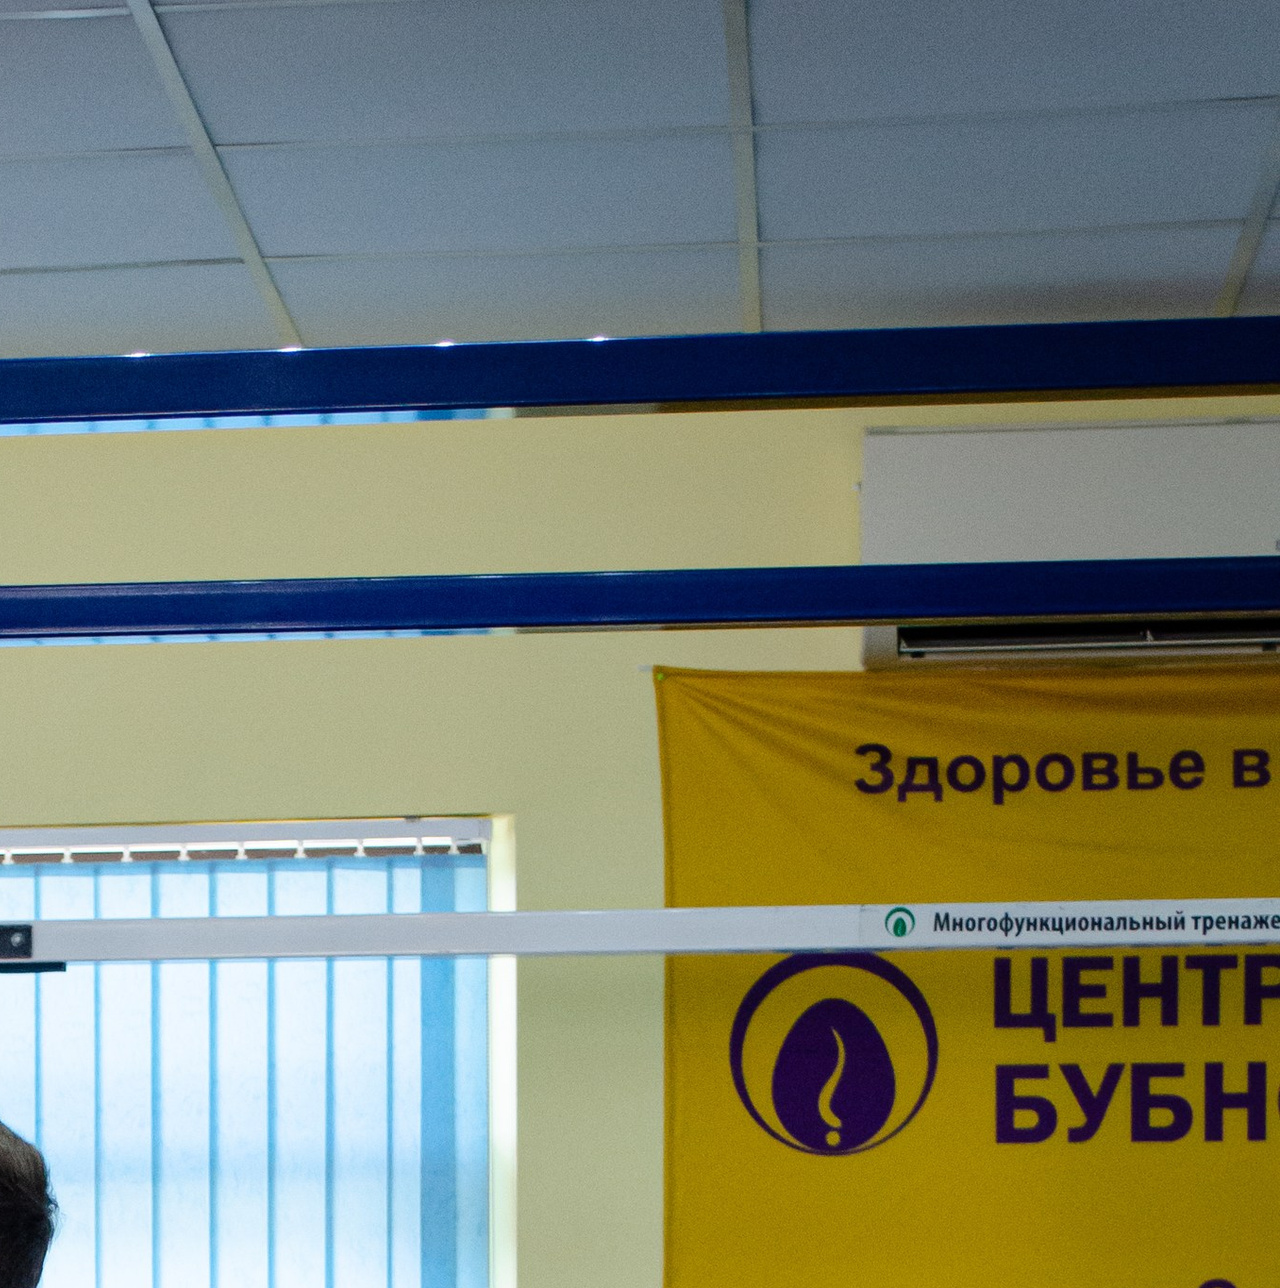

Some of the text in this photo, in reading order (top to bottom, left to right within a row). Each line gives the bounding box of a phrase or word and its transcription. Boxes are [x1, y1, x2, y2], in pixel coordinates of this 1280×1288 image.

[855, 743, 1272, 806] Здоровье в
[933, 910, 1186, 937] Многофункциональный
[994, 953, 1280, 1042] ЦЕНТР
[996, 1062, 1280, 1142] БУБН
